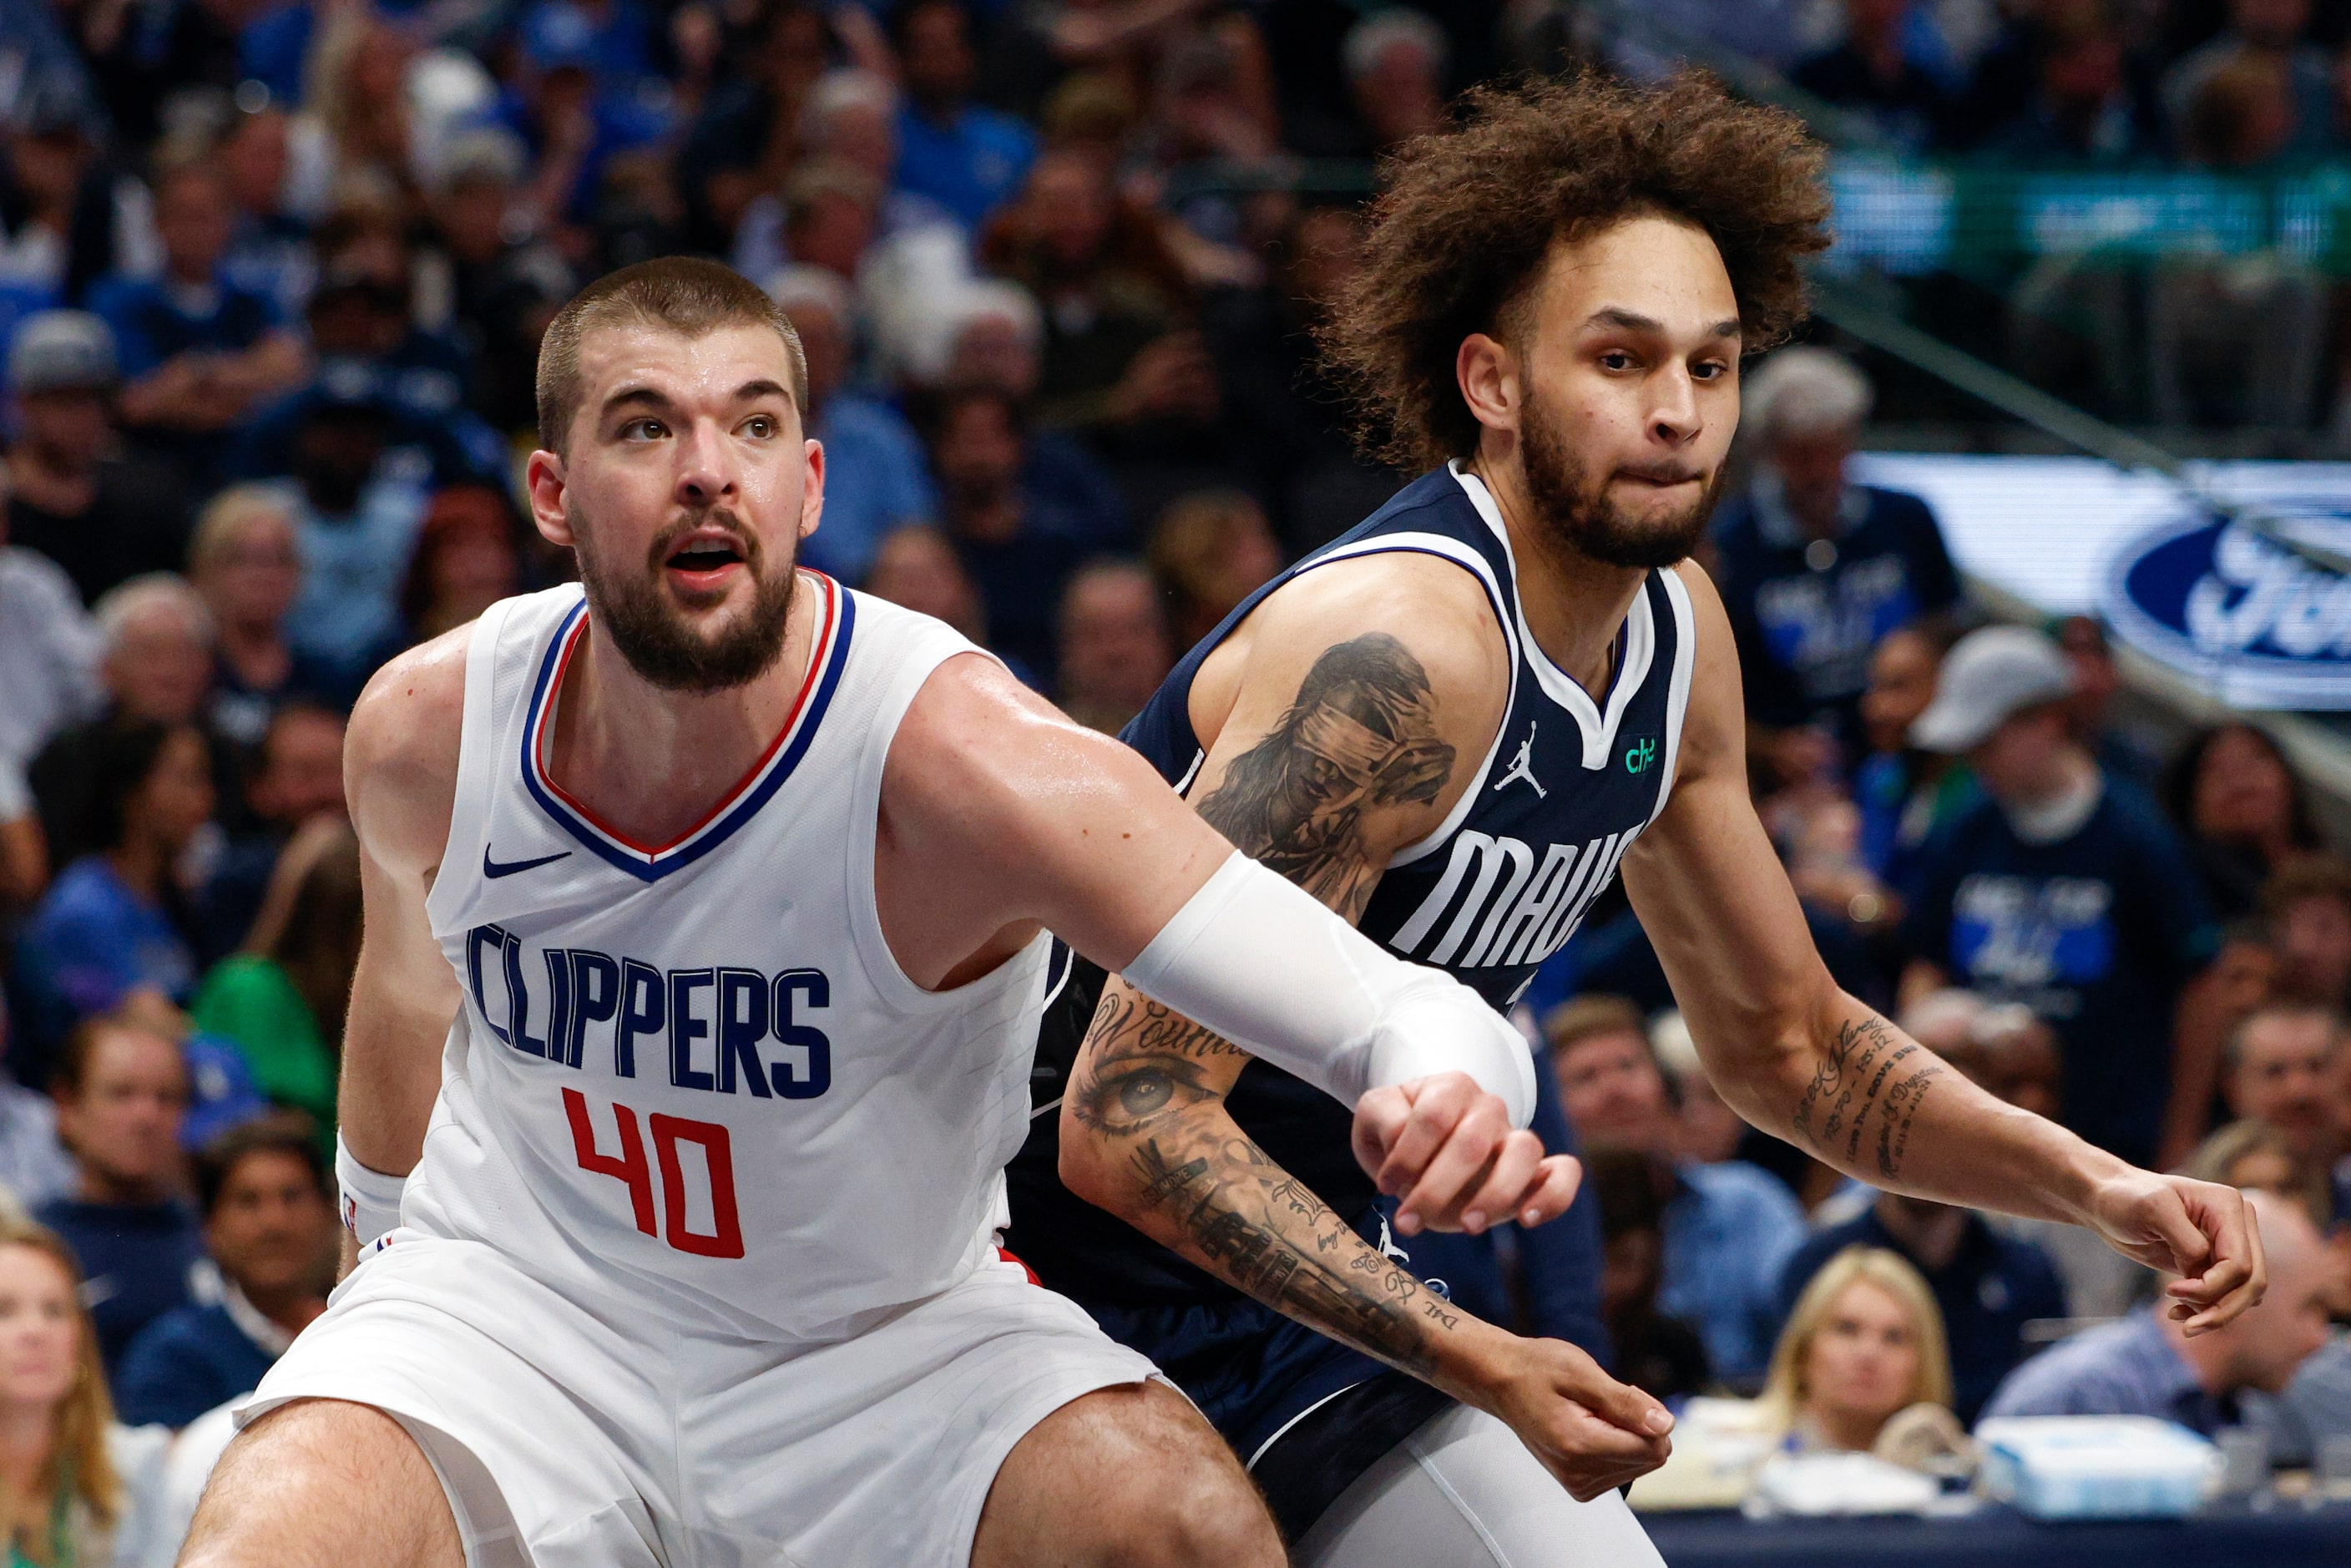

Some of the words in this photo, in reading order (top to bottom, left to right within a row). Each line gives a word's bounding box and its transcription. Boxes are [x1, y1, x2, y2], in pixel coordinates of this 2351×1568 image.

[466, 923, 831, 1100] CLIPPERS
[561, 1087, 745, 1259] 40
[1423, 1300, 1459, 1331] D4L
